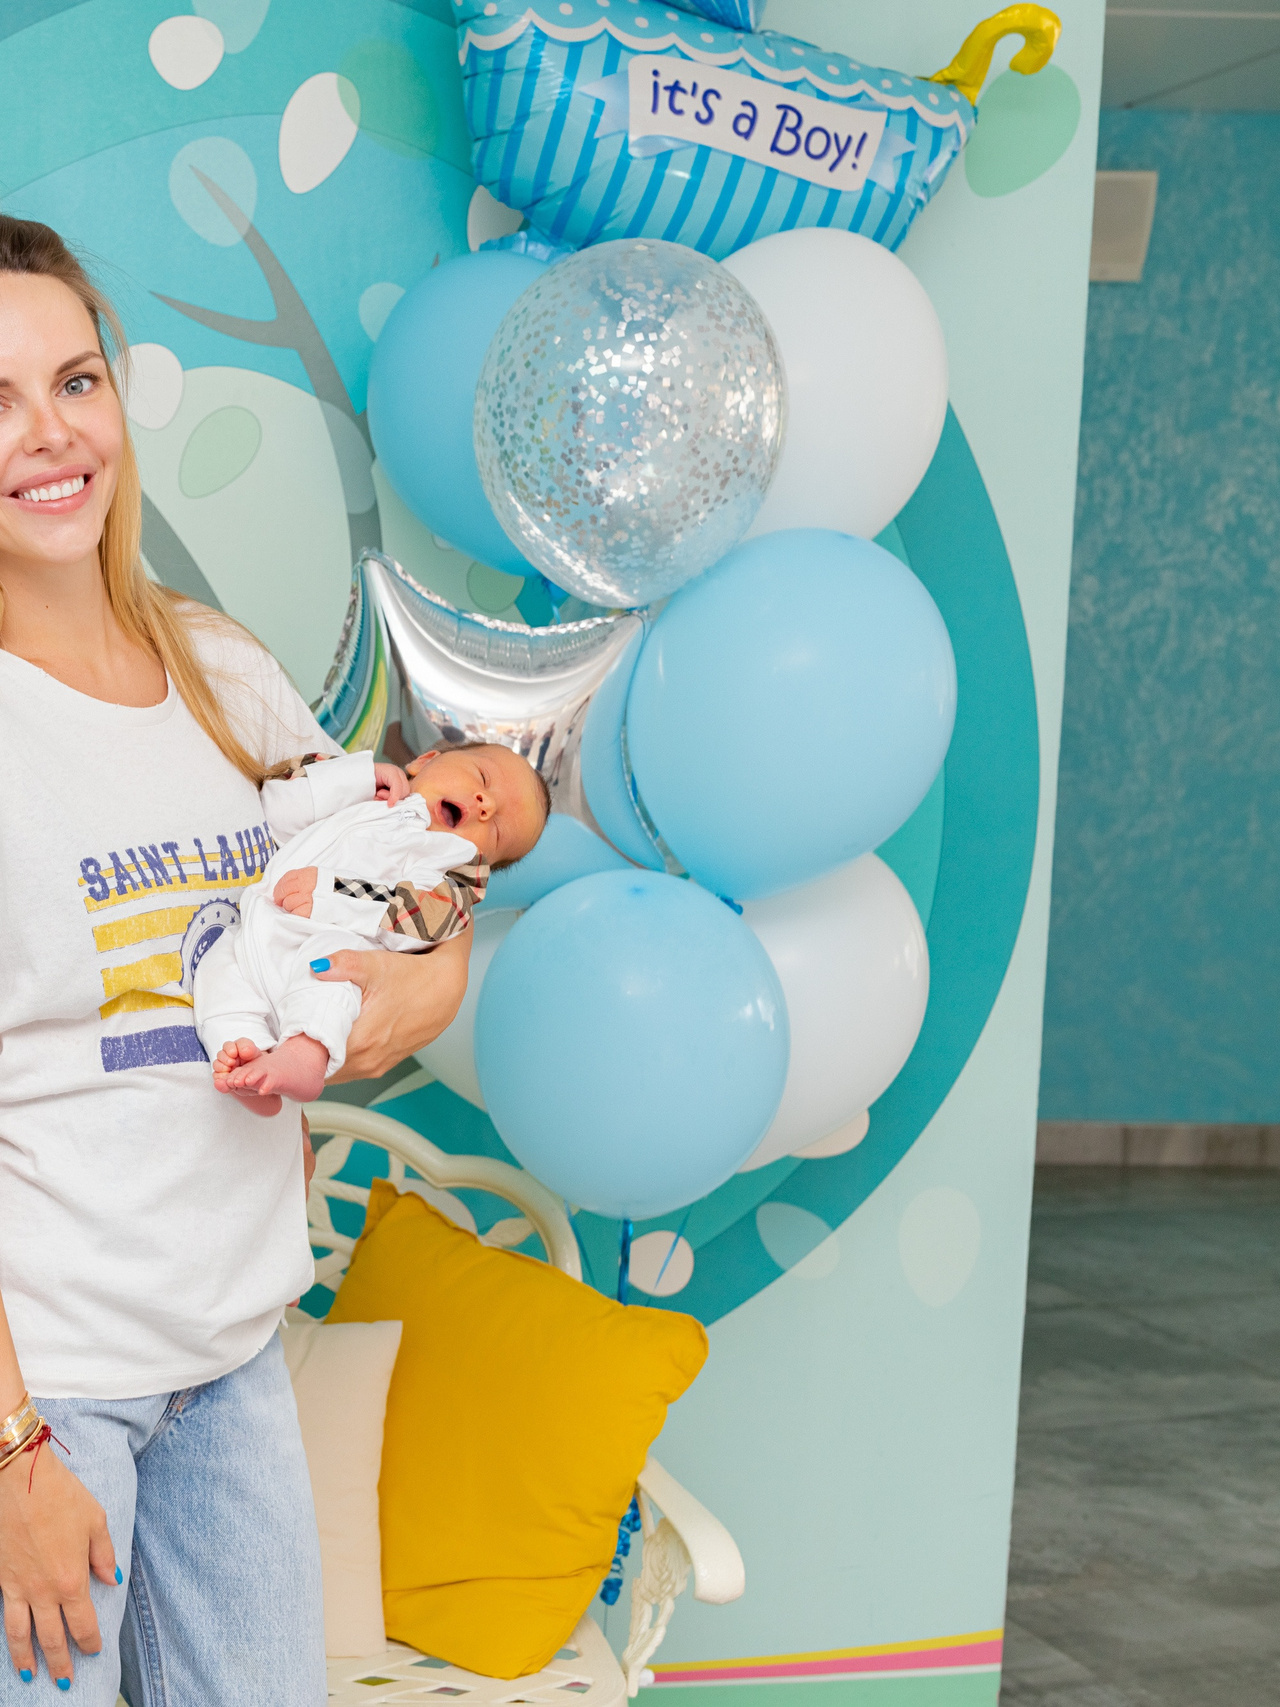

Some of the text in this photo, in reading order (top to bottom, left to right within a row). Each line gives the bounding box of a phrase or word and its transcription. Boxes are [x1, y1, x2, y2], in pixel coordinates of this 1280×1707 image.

[651, 69, 868, 173] it's a Boy!
[80, 841, 188, 902] SAINT
